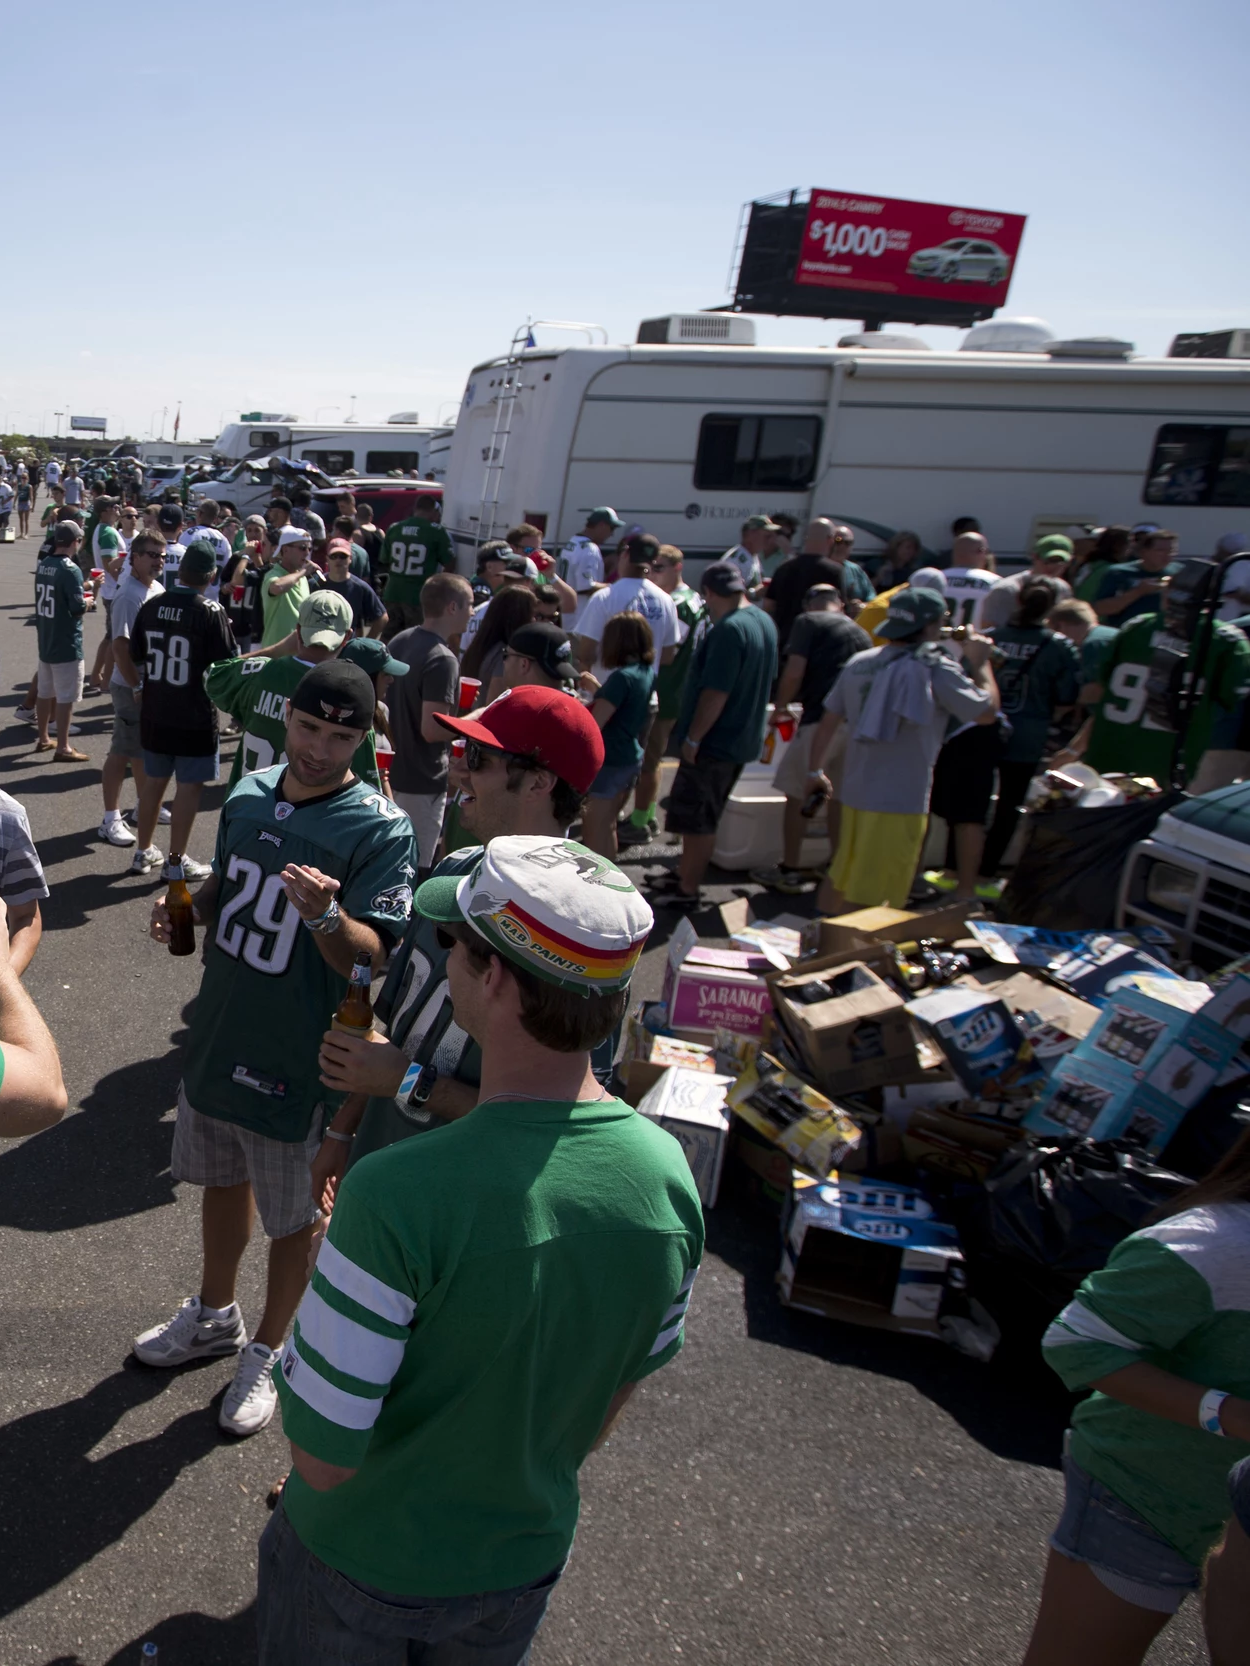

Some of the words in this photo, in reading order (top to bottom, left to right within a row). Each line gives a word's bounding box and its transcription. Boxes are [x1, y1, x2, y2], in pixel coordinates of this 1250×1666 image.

[809, 219, 888, 258] $1,000
[390, 541, 427, 576] 92
[36, 584, 56, 618] 25
[157, 606, 183, 622] COLE
[146, 631, 190, 686] 58
[215, 853, 302, 976] 29
[530, 943, 588, 974] PAINTS
[698, 985, 769, 1014] SARANAC
[698, 1008, 761, 1026] PRISM
